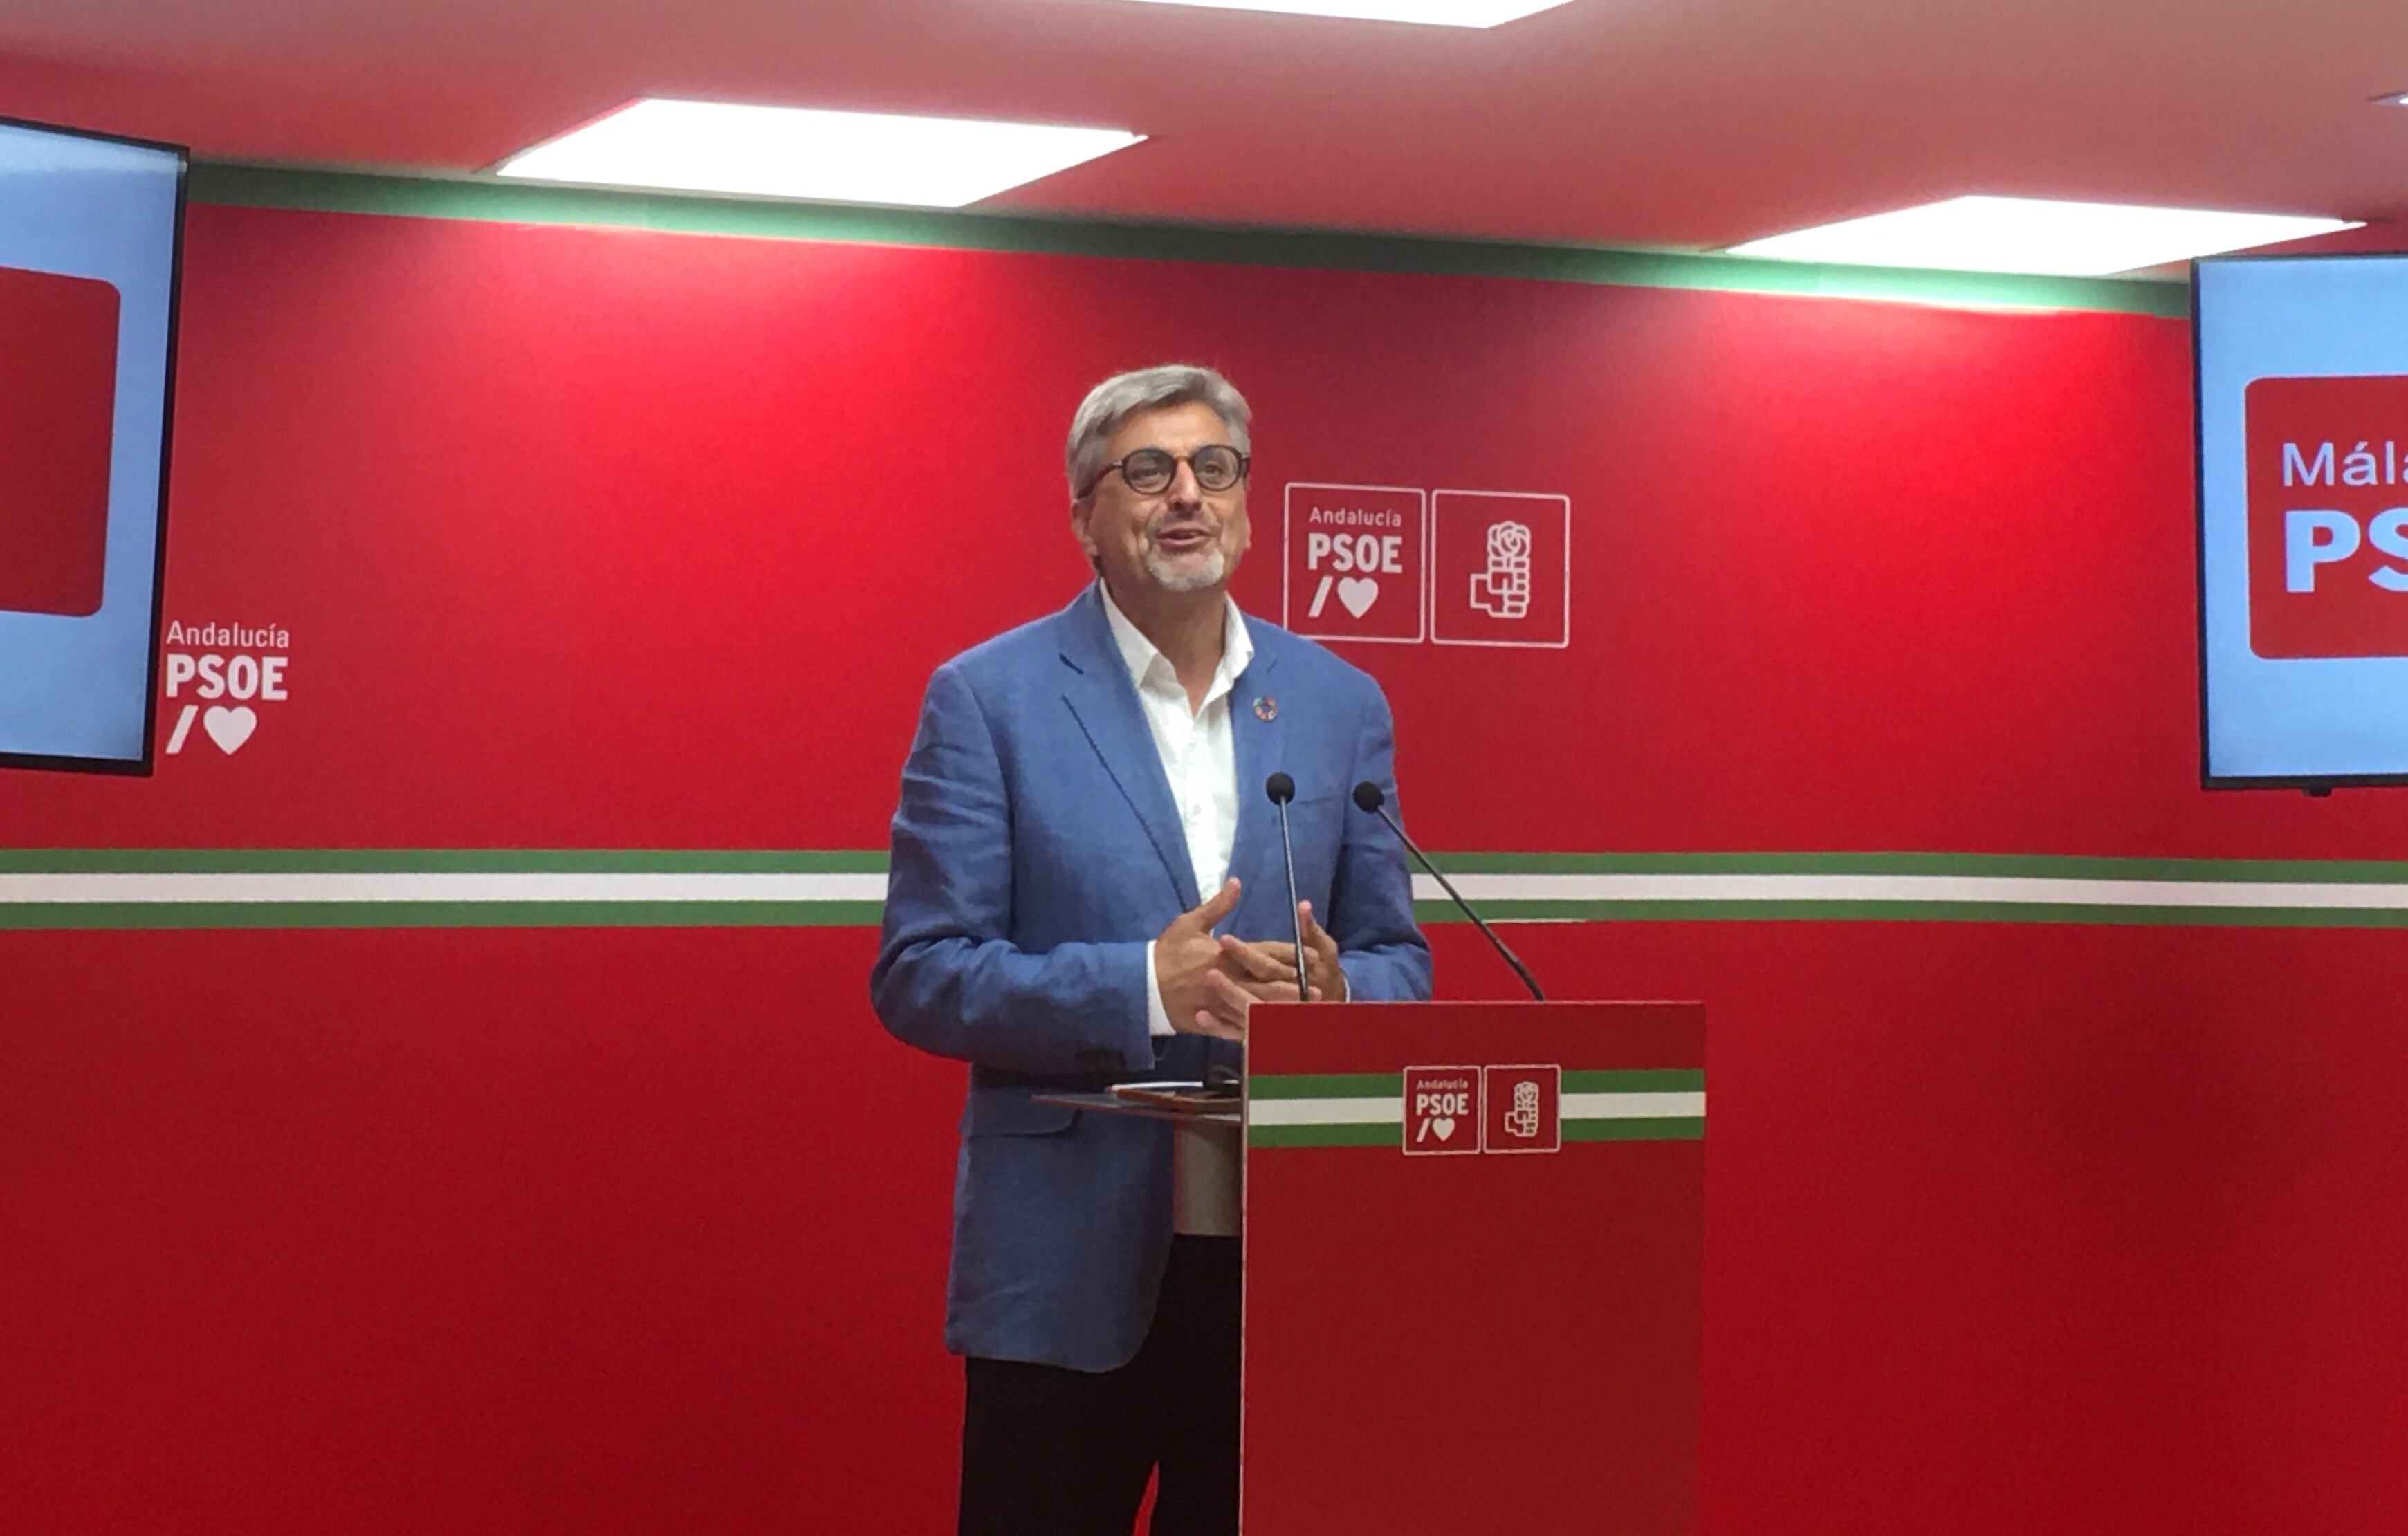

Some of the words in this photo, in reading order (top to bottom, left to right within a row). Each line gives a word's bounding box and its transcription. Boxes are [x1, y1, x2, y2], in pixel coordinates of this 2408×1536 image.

[2283, 441, 2408, 487] Mál
[1309, 506, 1401, 527] Andalucía
[1309, 533, 1402, 573] PSOE
[166, 620, 289, 648] Andalucía
[166, 654, 288, 701] PSOE
[1416, 1093, 1469, 1116] PSOE
